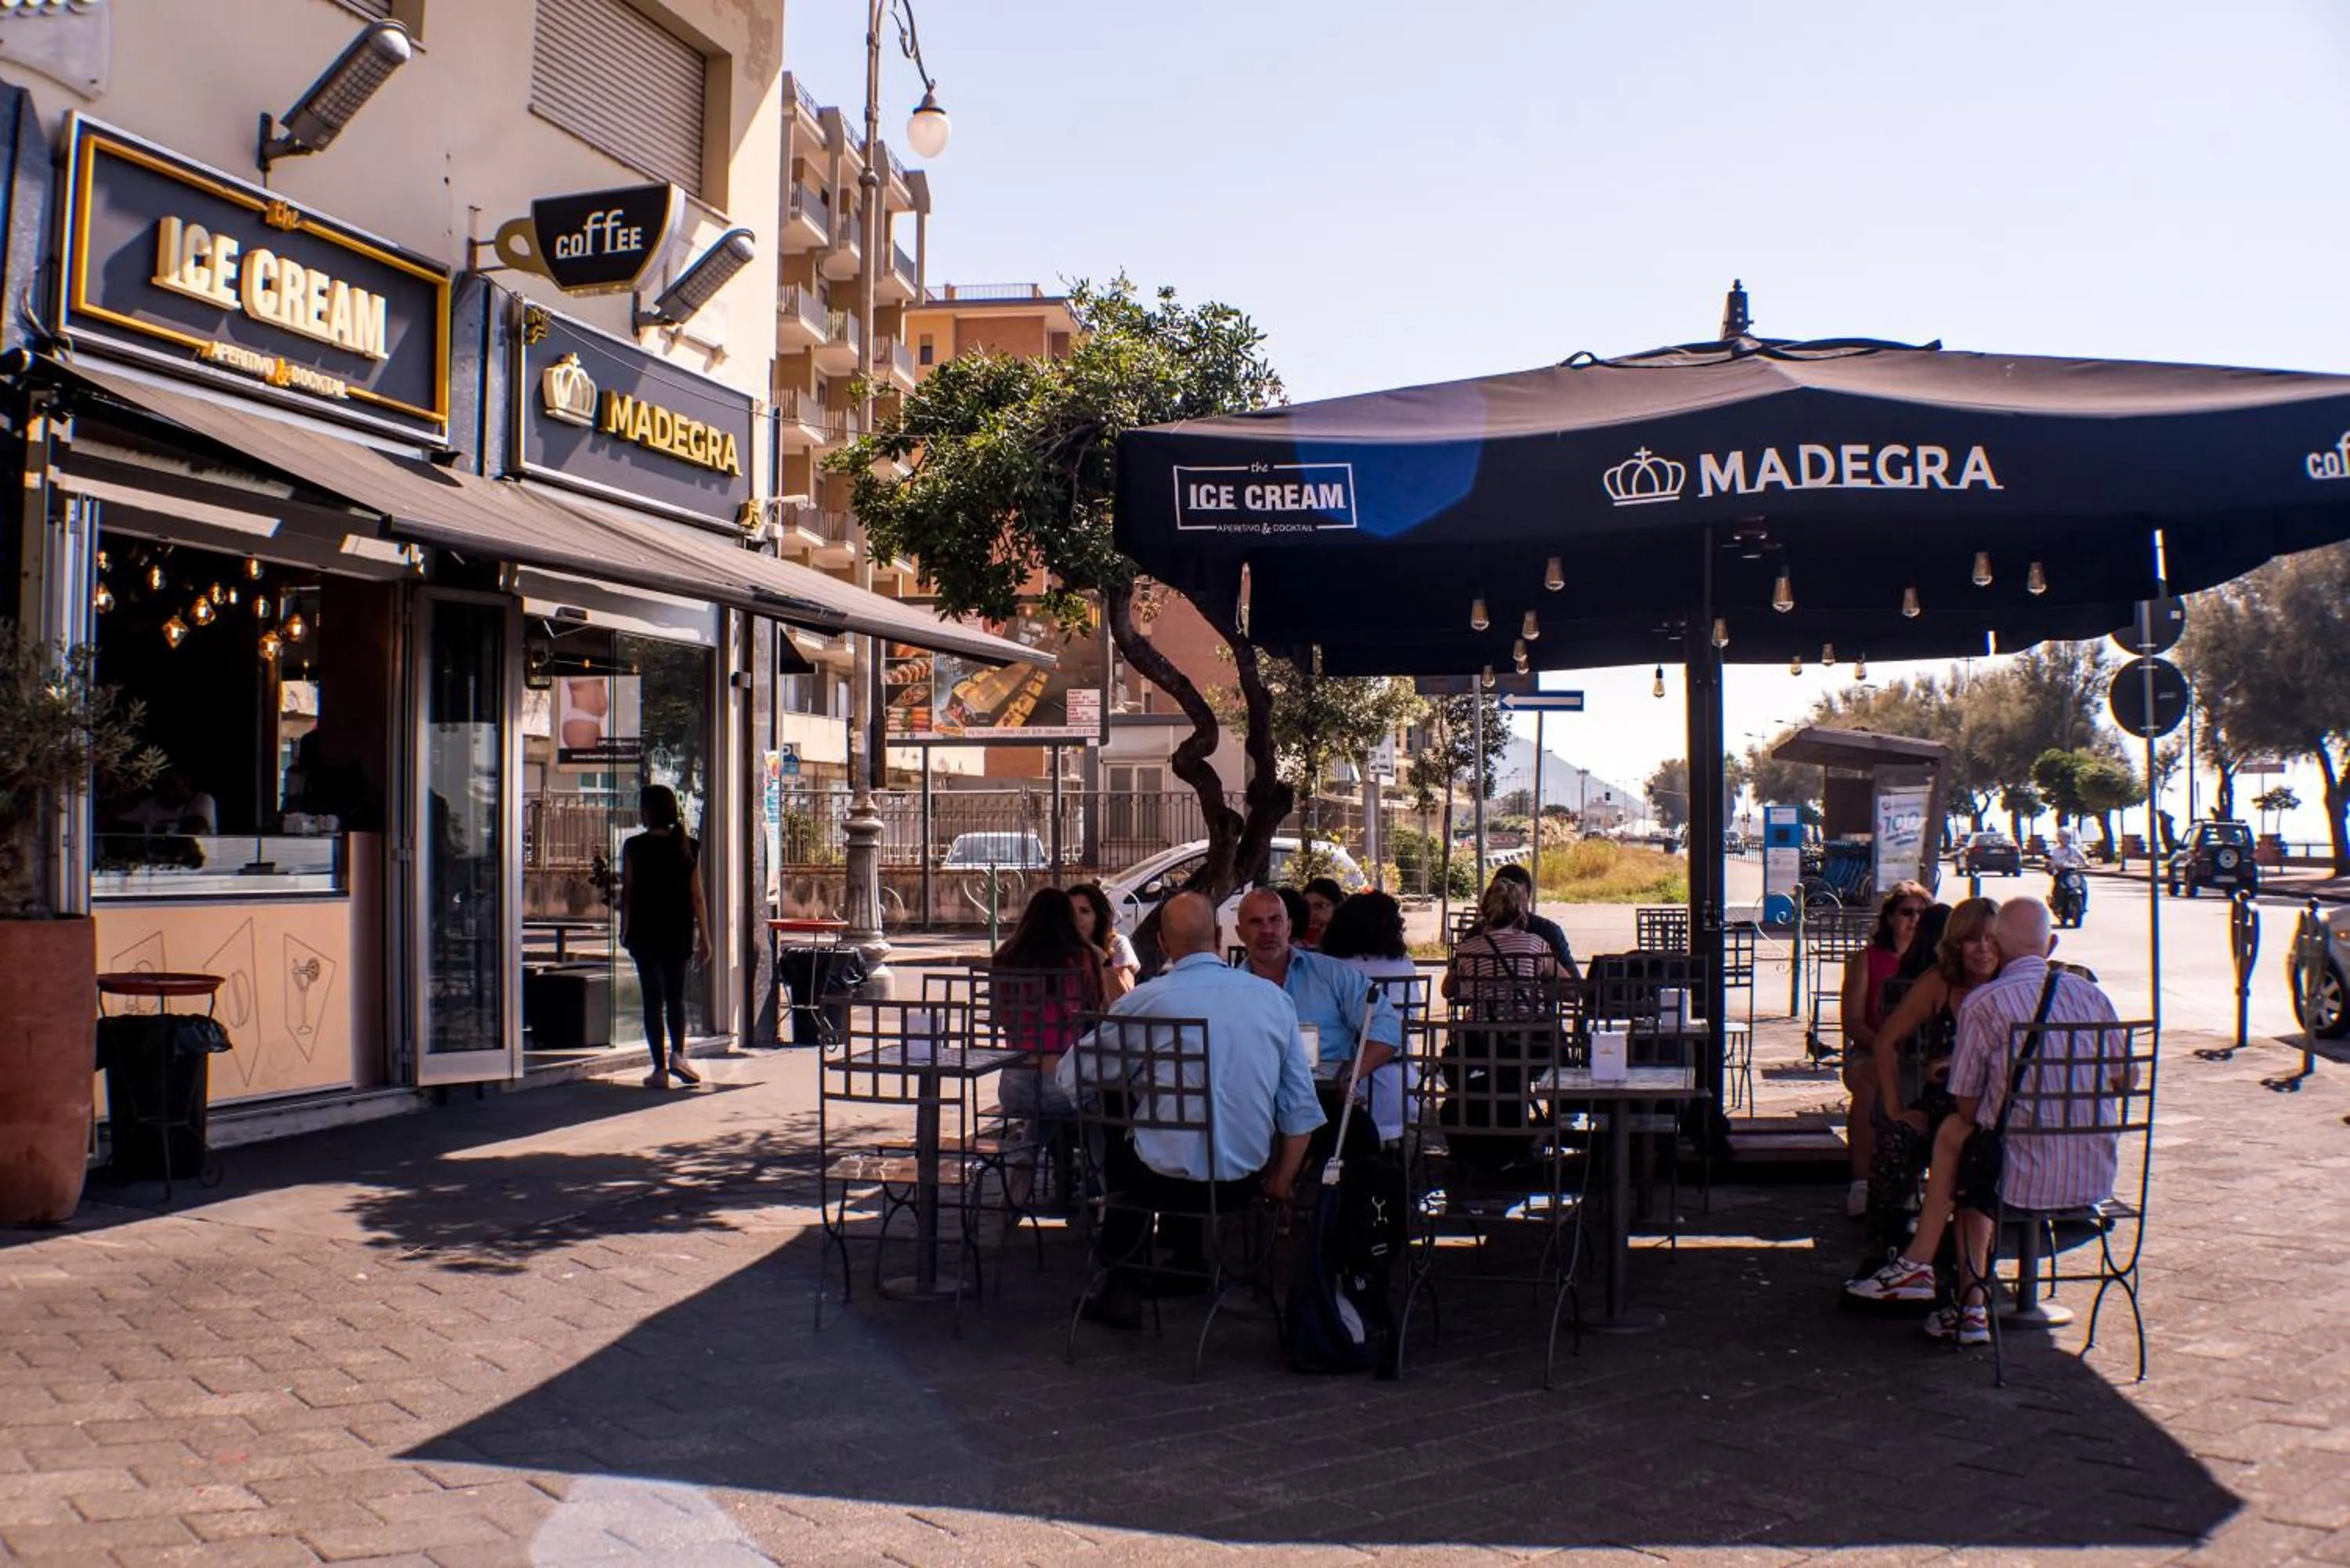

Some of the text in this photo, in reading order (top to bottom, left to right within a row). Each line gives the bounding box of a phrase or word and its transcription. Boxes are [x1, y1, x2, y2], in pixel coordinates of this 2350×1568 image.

[267, 200, 300, 230] the
[152, 215, 389, 360] ICE CREAM
[600, 391, 742, 476] MADEGRA
[1251, 461, 1268, 473] the
[1698, 443, 2005, 497] MADEGRA
[1188, 483, 1347, 510] ICE CREAM
[1261, 522, 1271, 535] &
